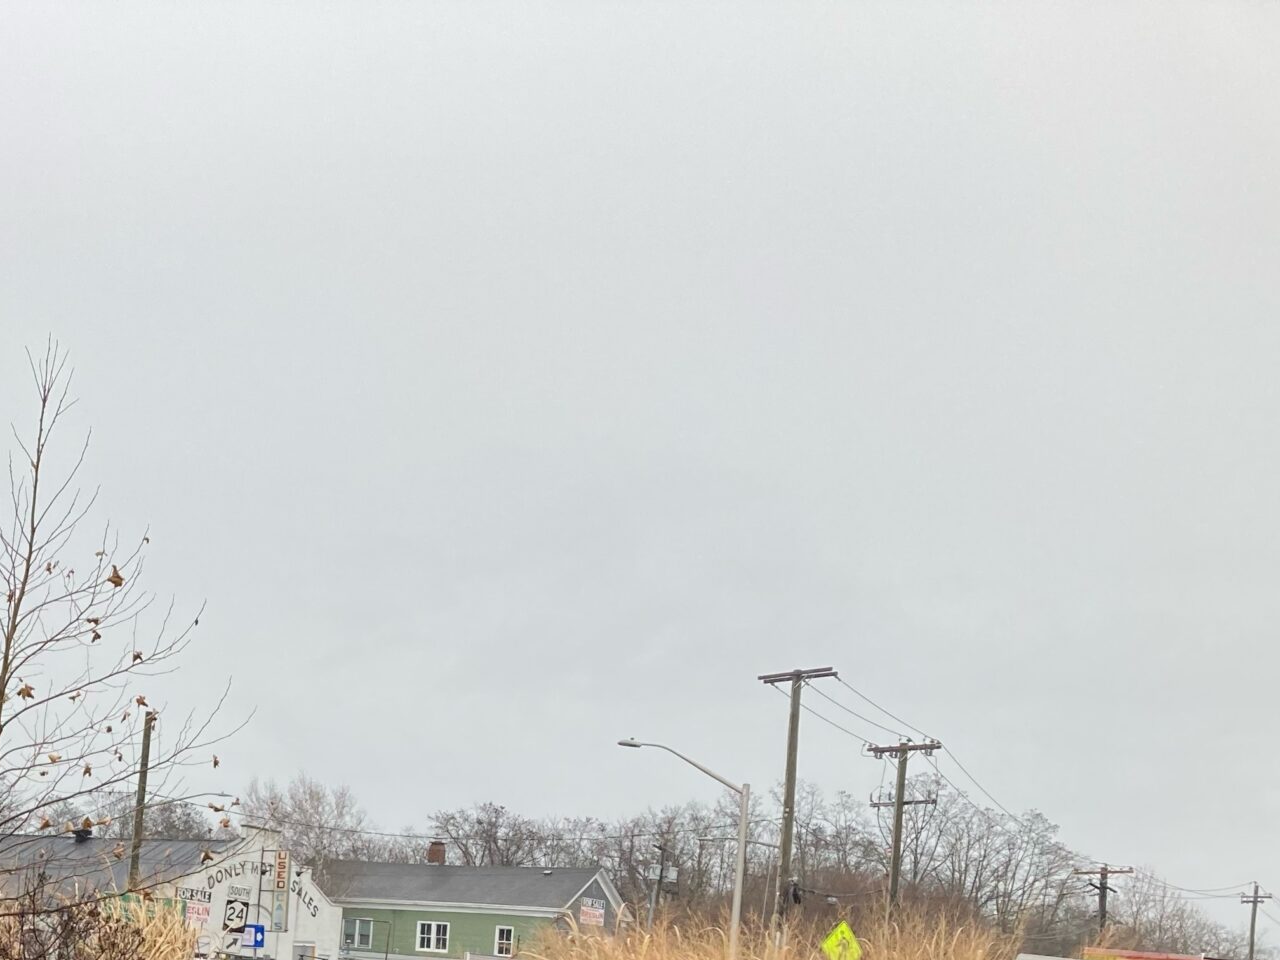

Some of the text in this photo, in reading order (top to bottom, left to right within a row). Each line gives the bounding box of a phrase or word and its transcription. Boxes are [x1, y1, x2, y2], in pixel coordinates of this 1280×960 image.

[192, 890, 210, 902] SALE
[207, 862, 245, 889] DONLY
[290, 880, 319, 918] SALES
[230, 885, 250, 897] SOUTH
[274, 852, 287, 930] USED CAS
[226, 906, 244, 922] 24
